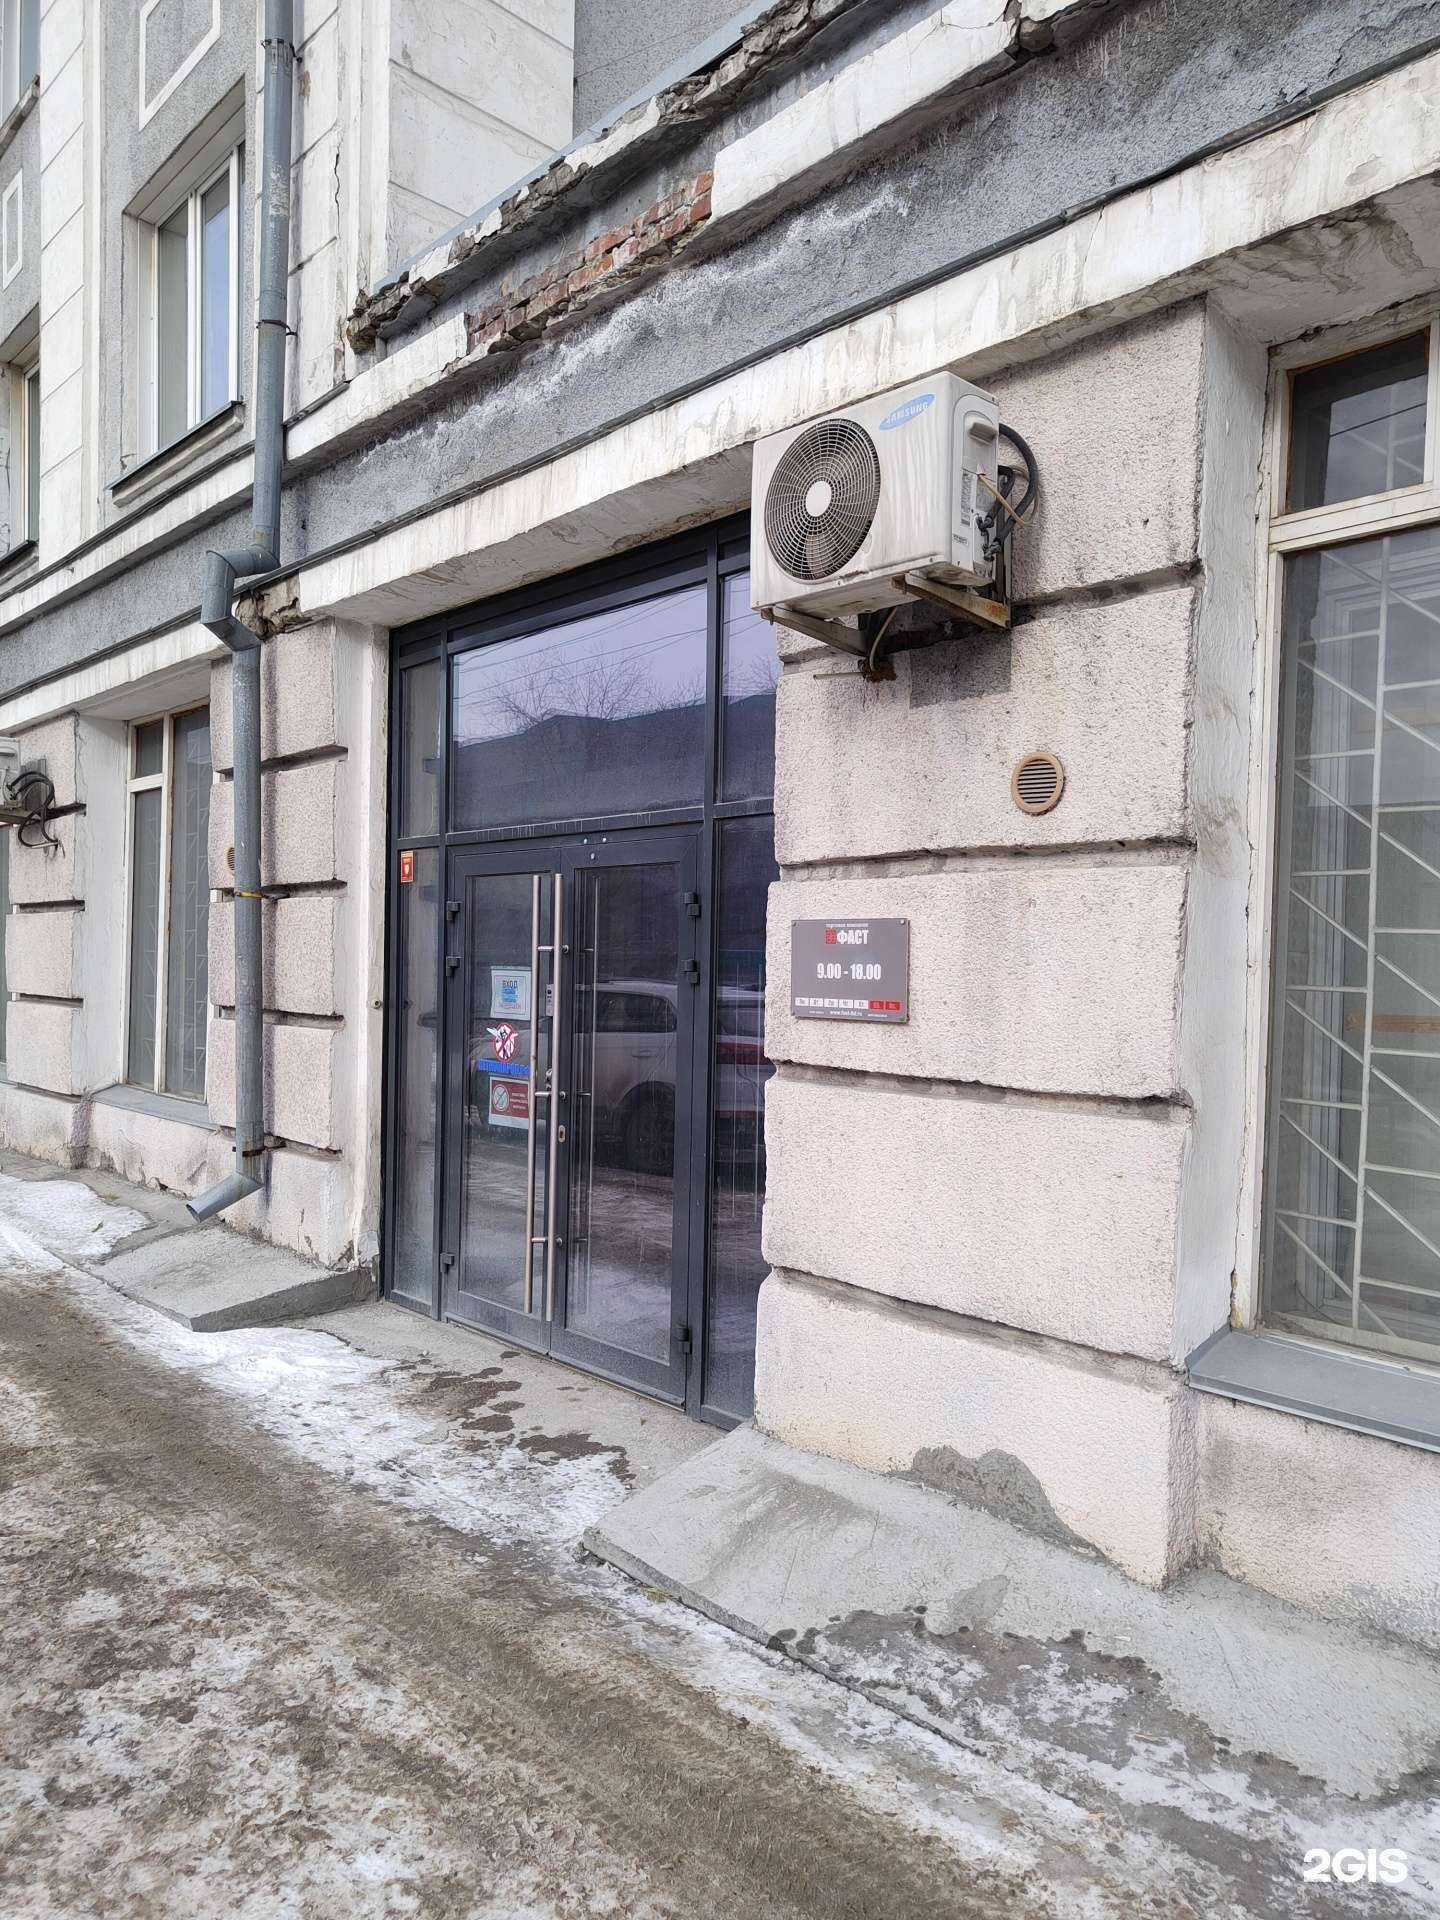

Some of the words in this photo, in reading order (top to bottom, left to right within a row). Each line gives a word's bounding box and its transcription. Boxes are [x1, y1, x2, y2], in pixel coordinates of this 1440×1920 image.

[882, 401, 929, 424] SAMSUNG
[836, 929, 869, 945] ФАСТ
[816, 962, 842, 979] 9.00
[850, 963, 882, 980] 18.00
